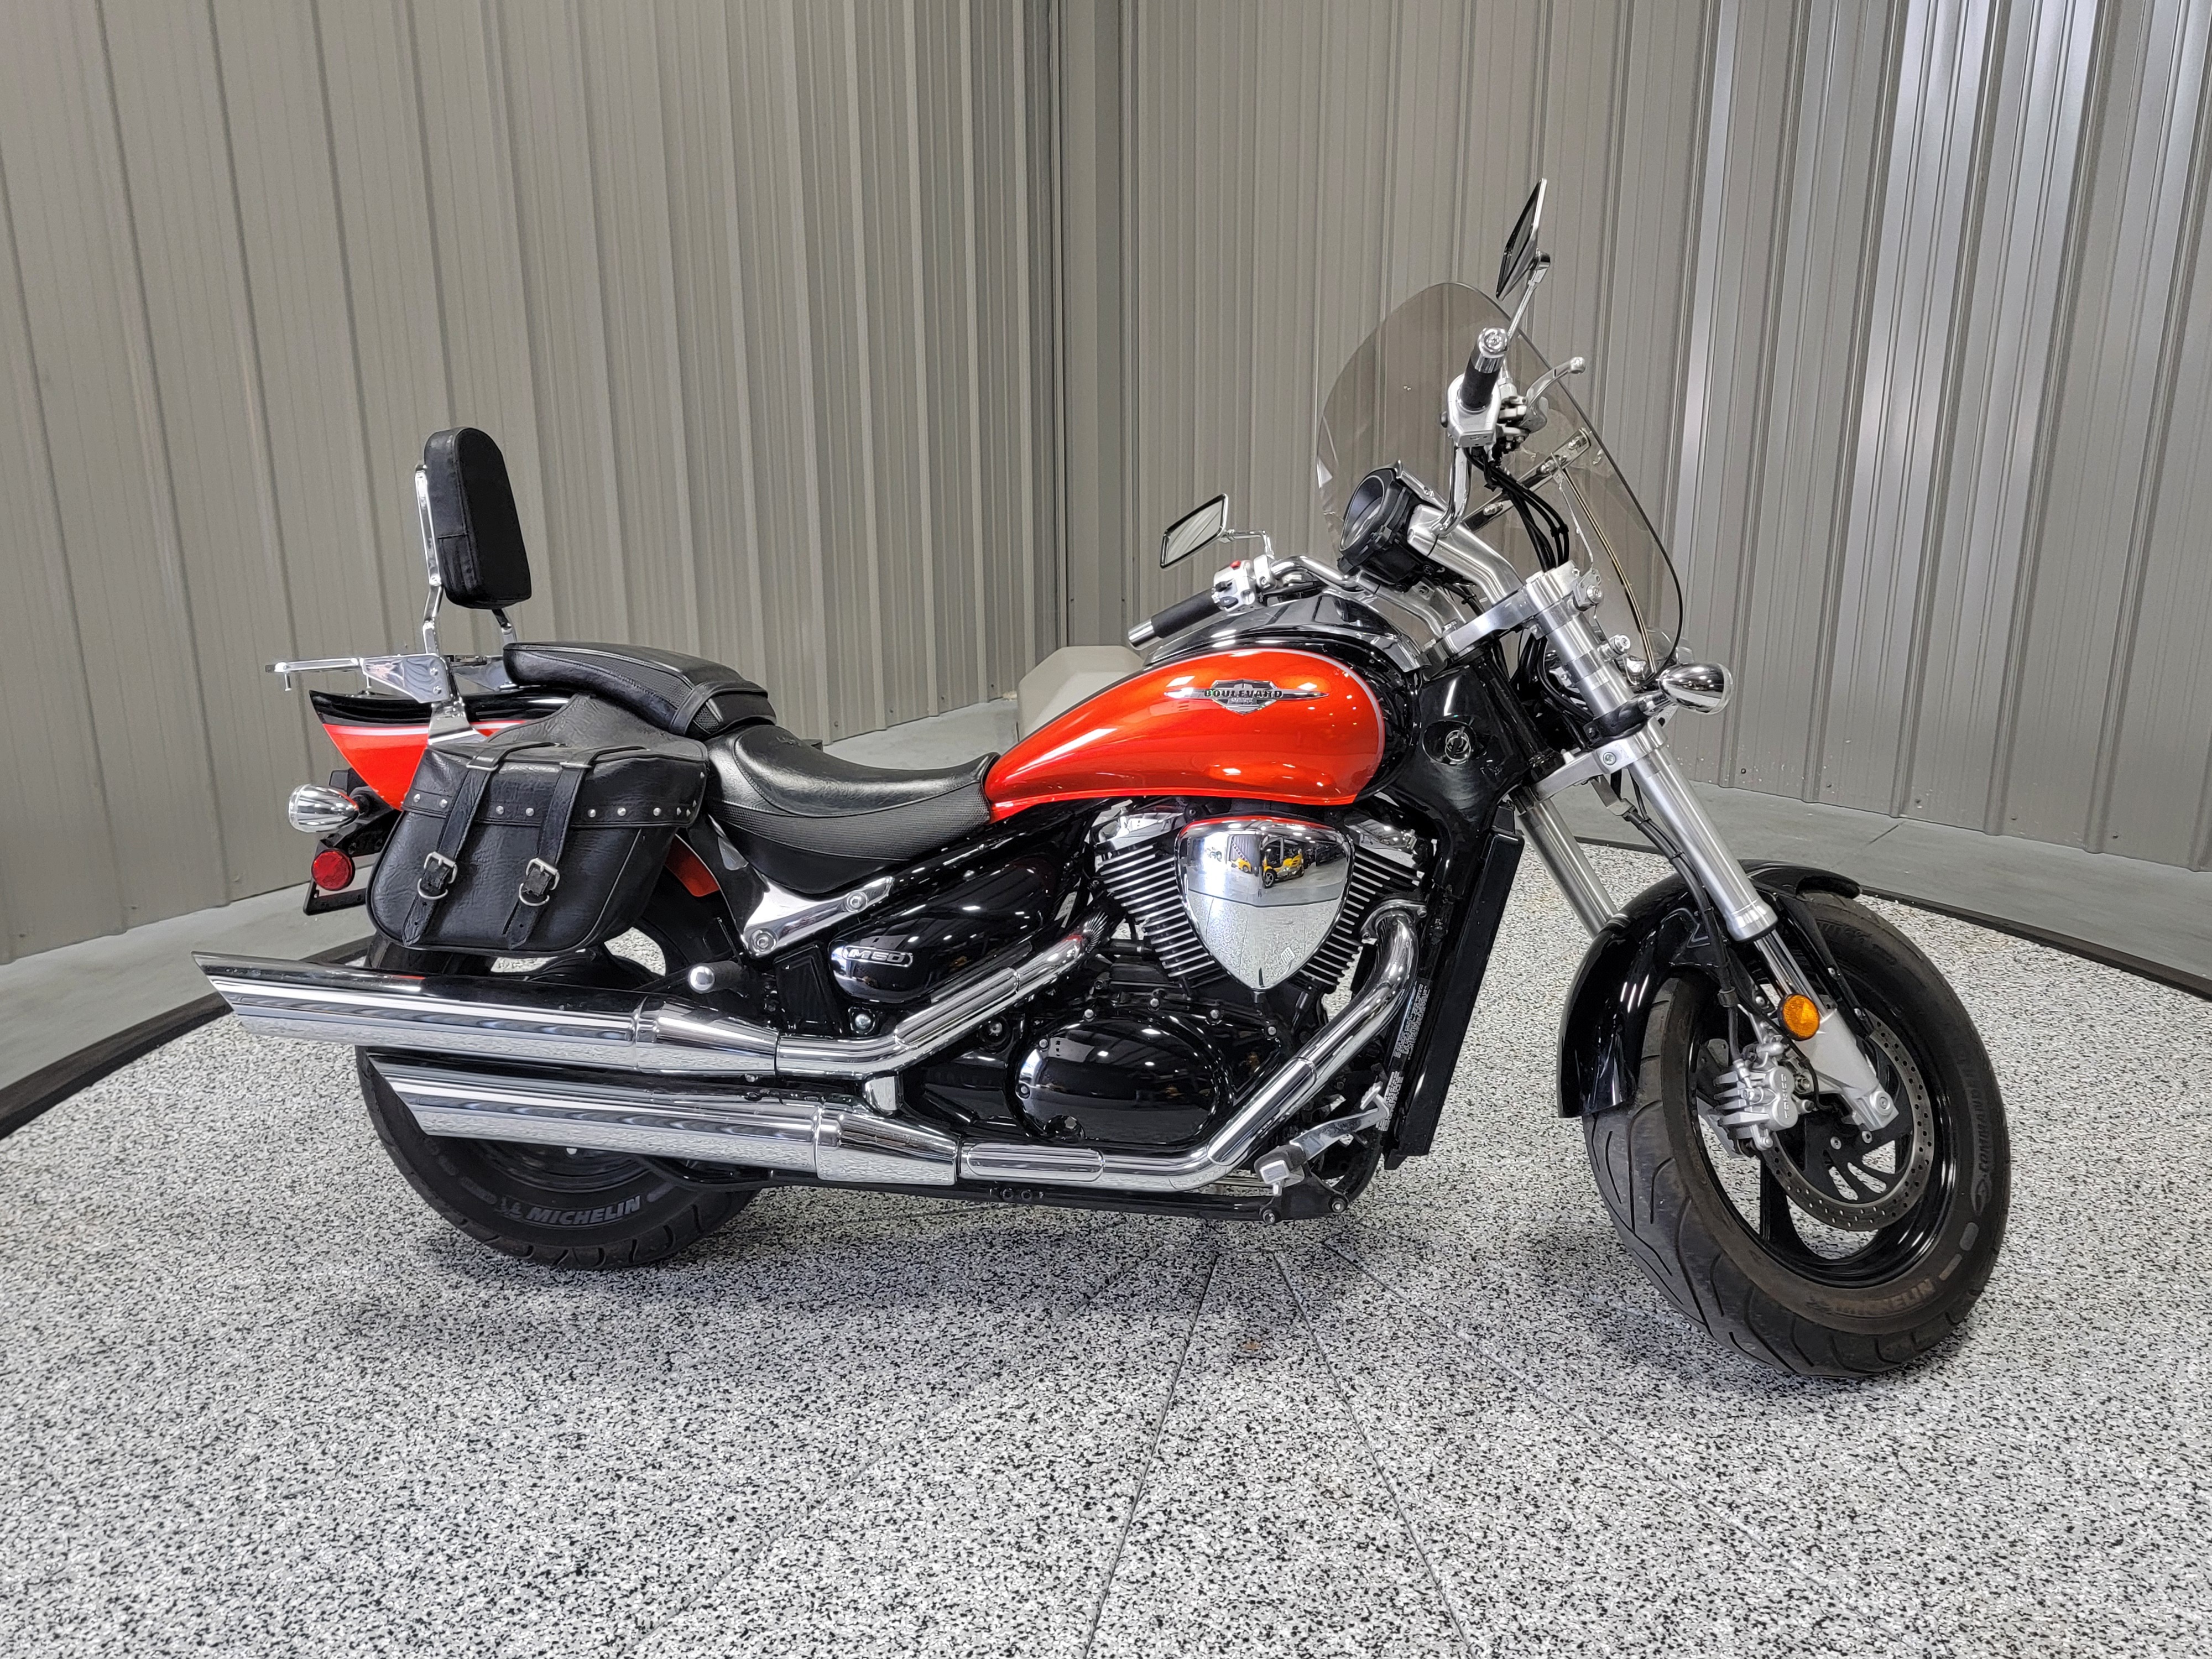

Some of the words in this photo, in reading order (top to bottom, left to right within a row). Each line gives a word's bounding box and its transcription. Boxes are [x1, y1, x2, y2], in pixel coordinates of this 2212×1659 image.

[1204, 690, 1282, 698] BOULEVARD
[526, 1195, 640, 1225] MICHELIN
[1833, 1278, 1936, 1316] HELIN
